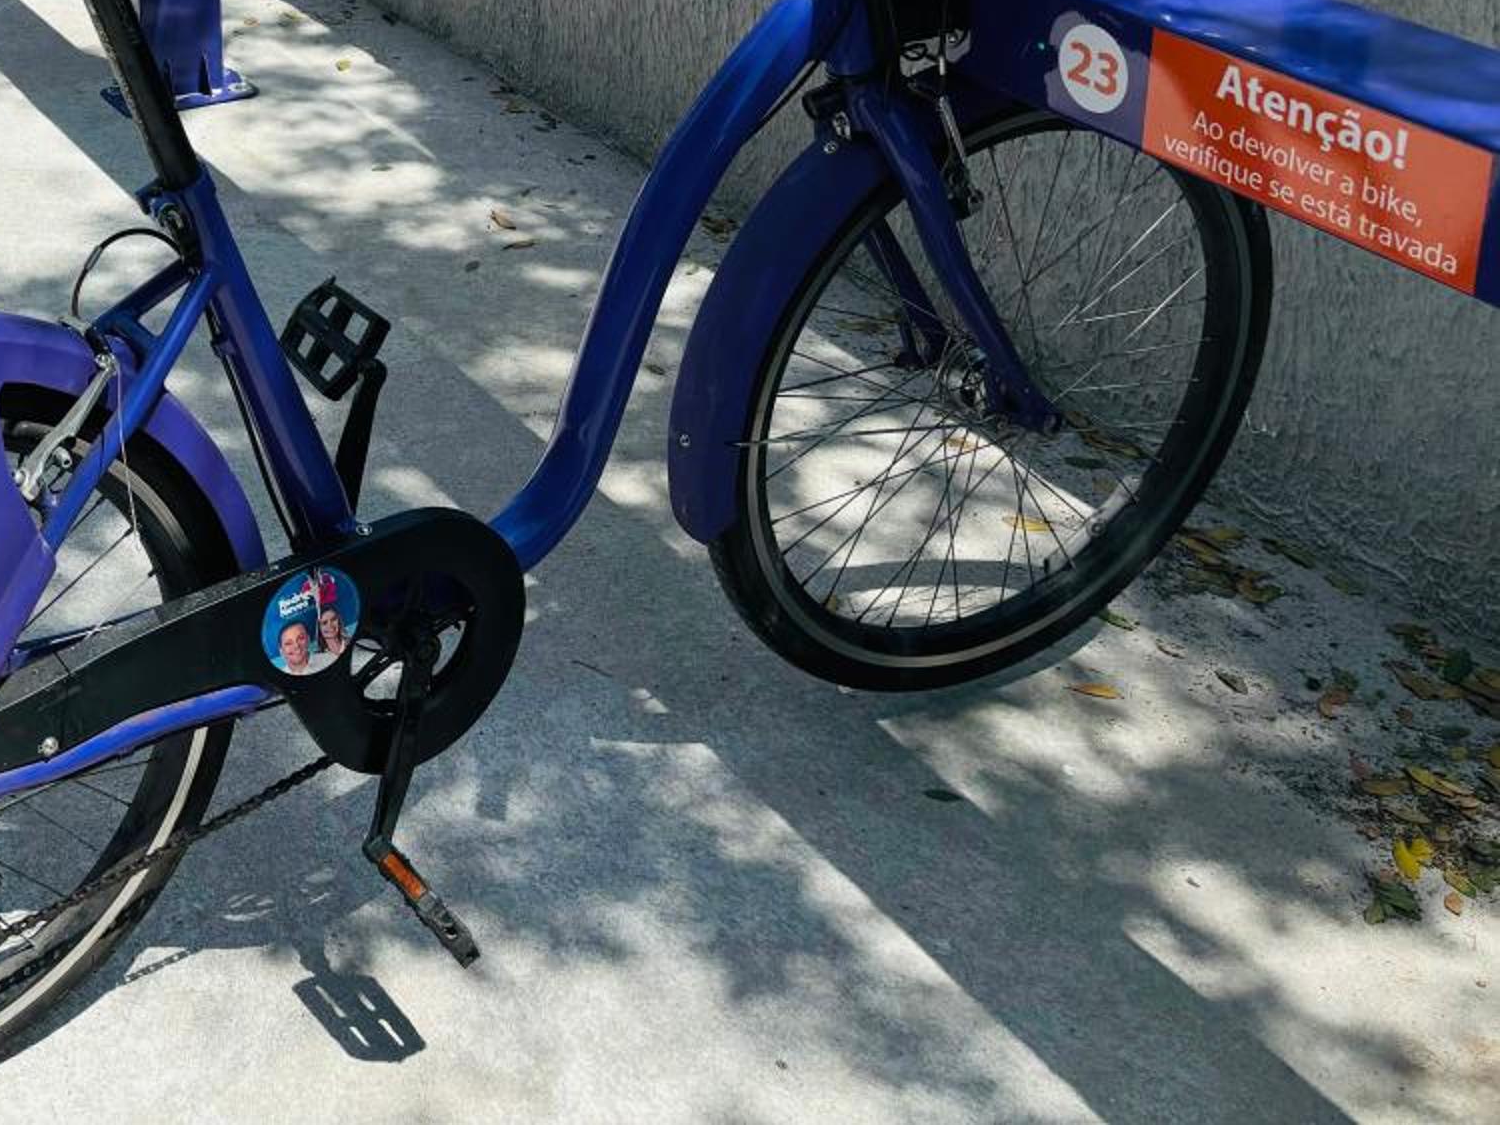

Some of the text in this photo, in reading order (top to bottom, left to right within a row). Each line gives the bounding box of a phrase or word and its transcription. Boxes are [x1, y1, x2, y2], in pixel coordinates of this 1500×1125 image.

[1066, 40, 1120, 98] 23
[1215, 64, 1409, 170] Atenção!
[1163, 134, 1458, 275] verifique se está travada
[1192, 110, 1423, 228] Ao devolver a bike,
